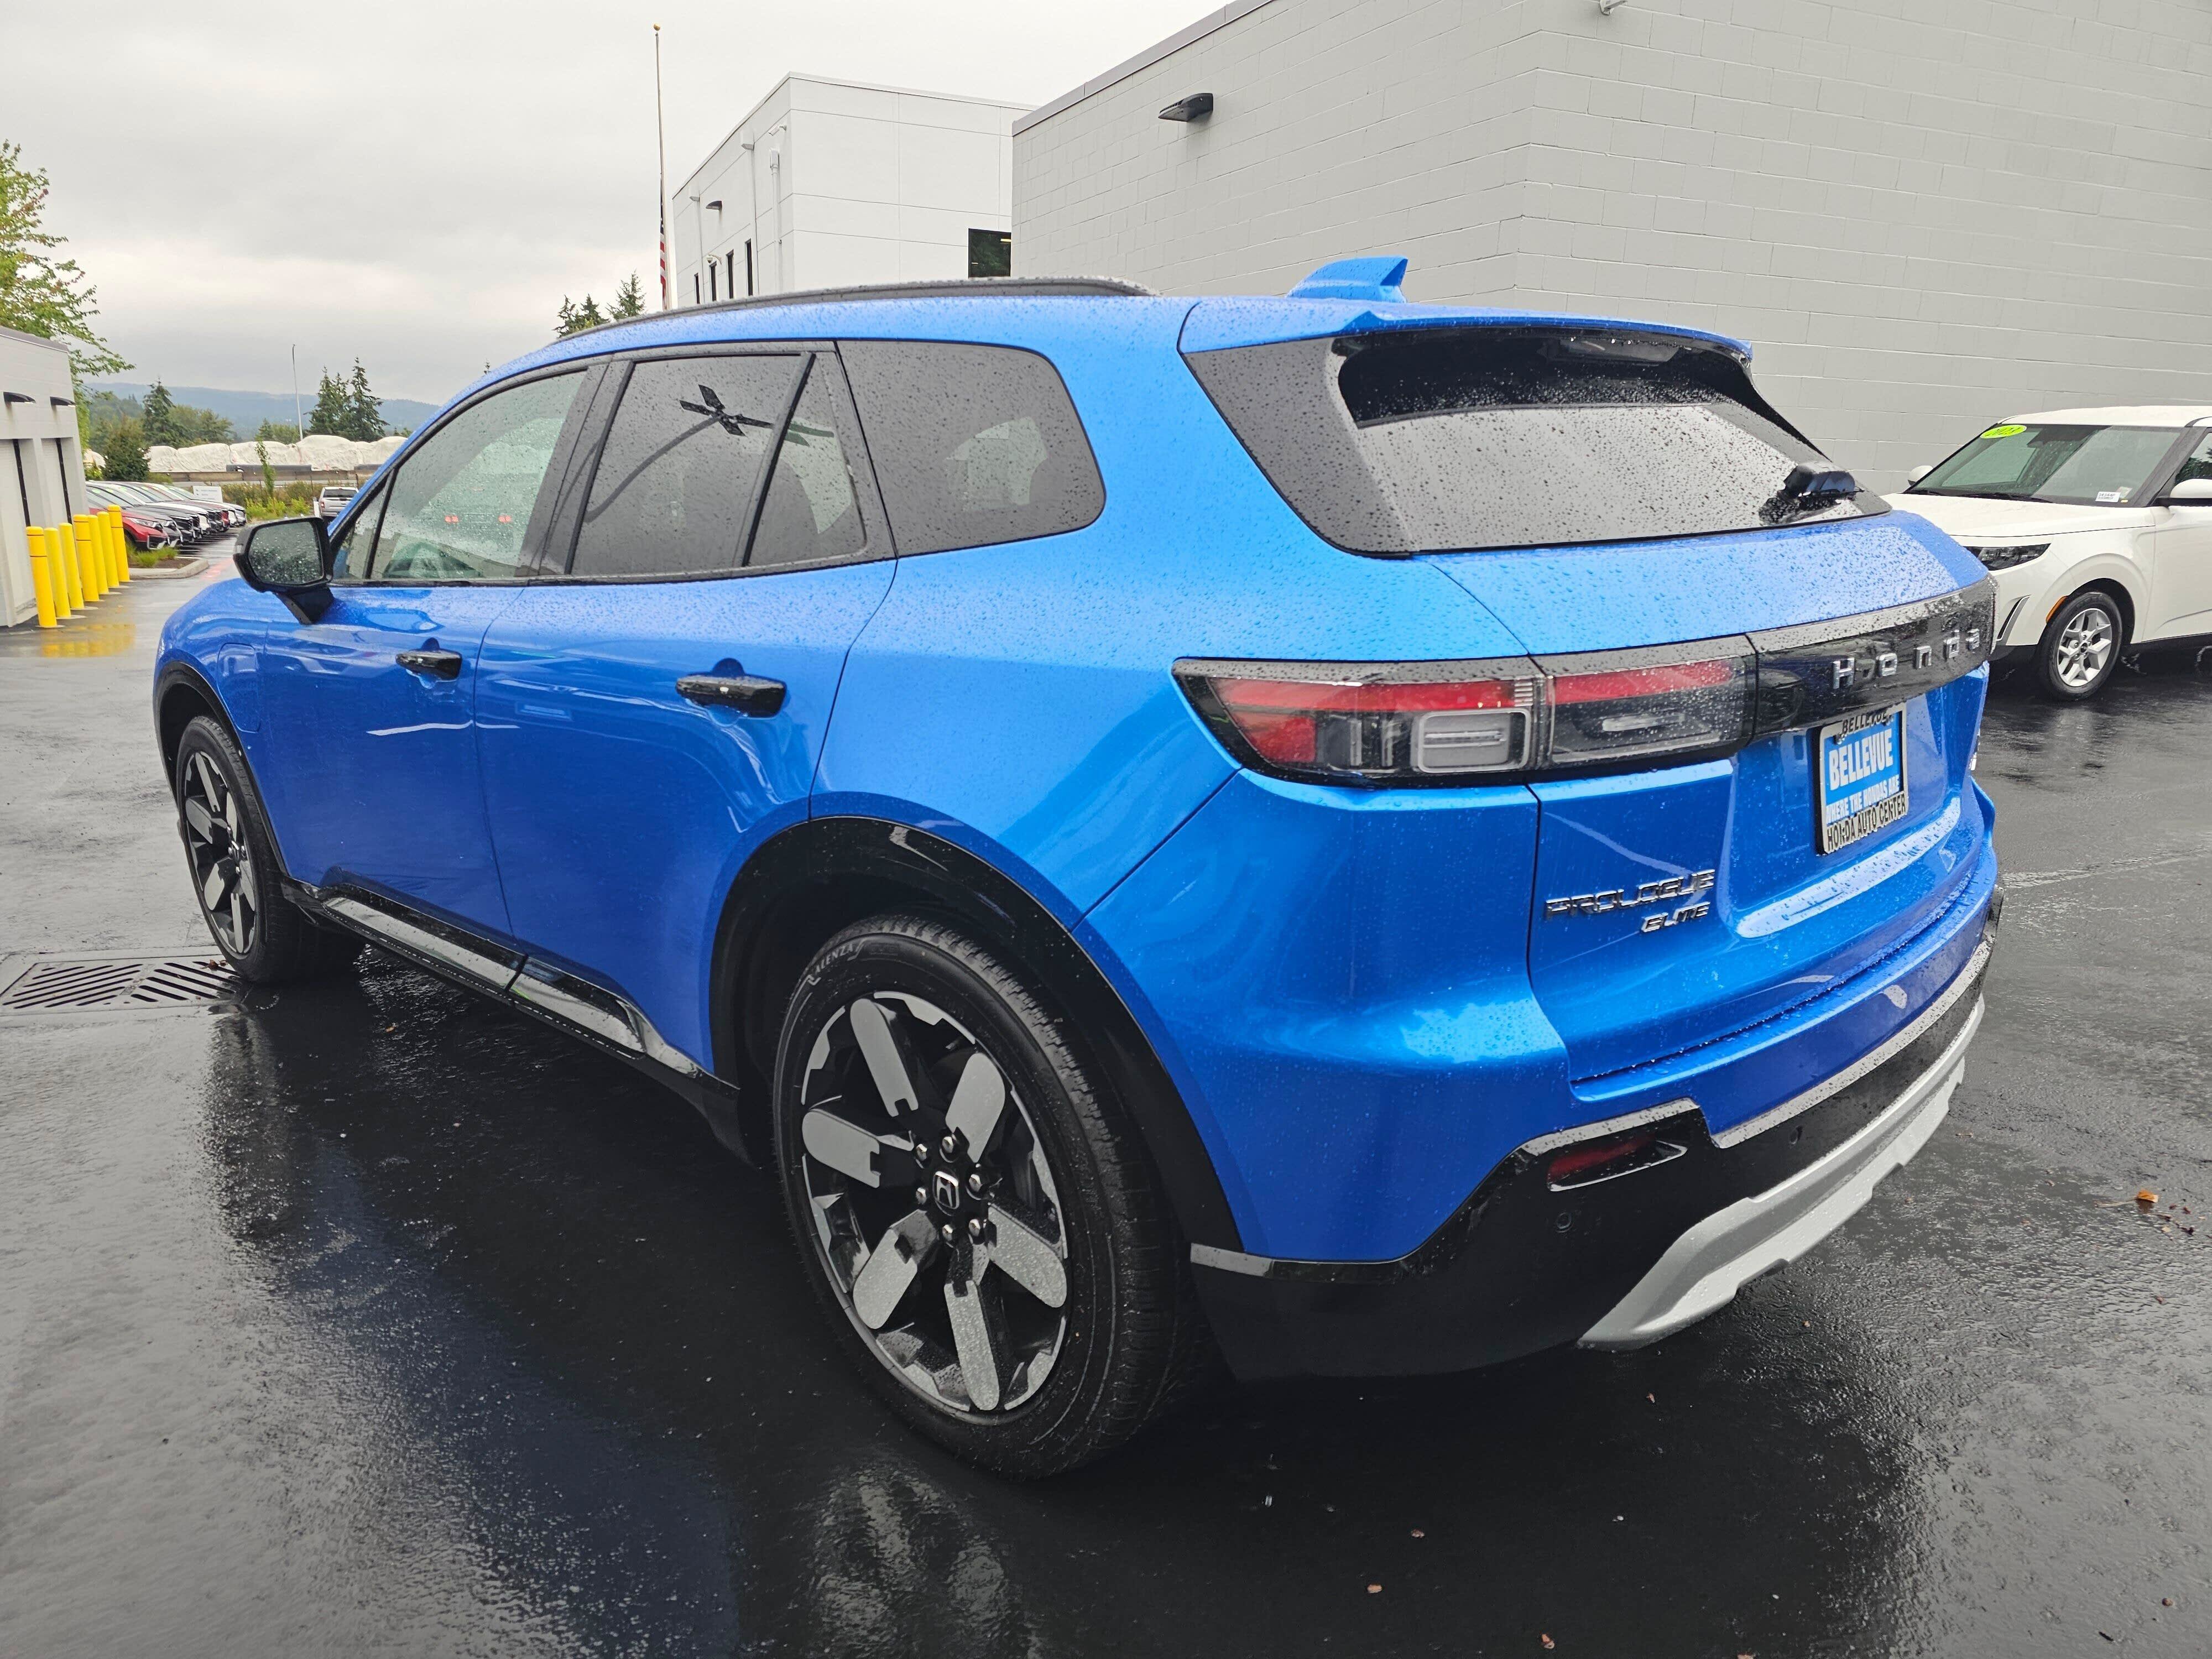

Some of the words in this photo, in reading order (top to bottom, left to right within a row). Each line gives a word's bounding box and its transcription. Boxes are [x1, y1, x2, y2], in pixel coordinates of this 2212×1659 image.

[1842, 711, 1888, 734] BELLEVUE
[1829, 729, 1893, 791] BELLEVUE
[1827, 797, 1849, 824] WHERE
[1888, 774, 1900, 796] ARE
[1827, 818, 1856, 851] HONDA
[1858, 807, 1877, 835] AUTO
[1880, 793, 1906, 823] CENTER
[1546, 869, 1715, 916] PROLOGUE
[1641, 902, 1710, 933] ELITE
[816, 942, 854, 973] ALENZA
